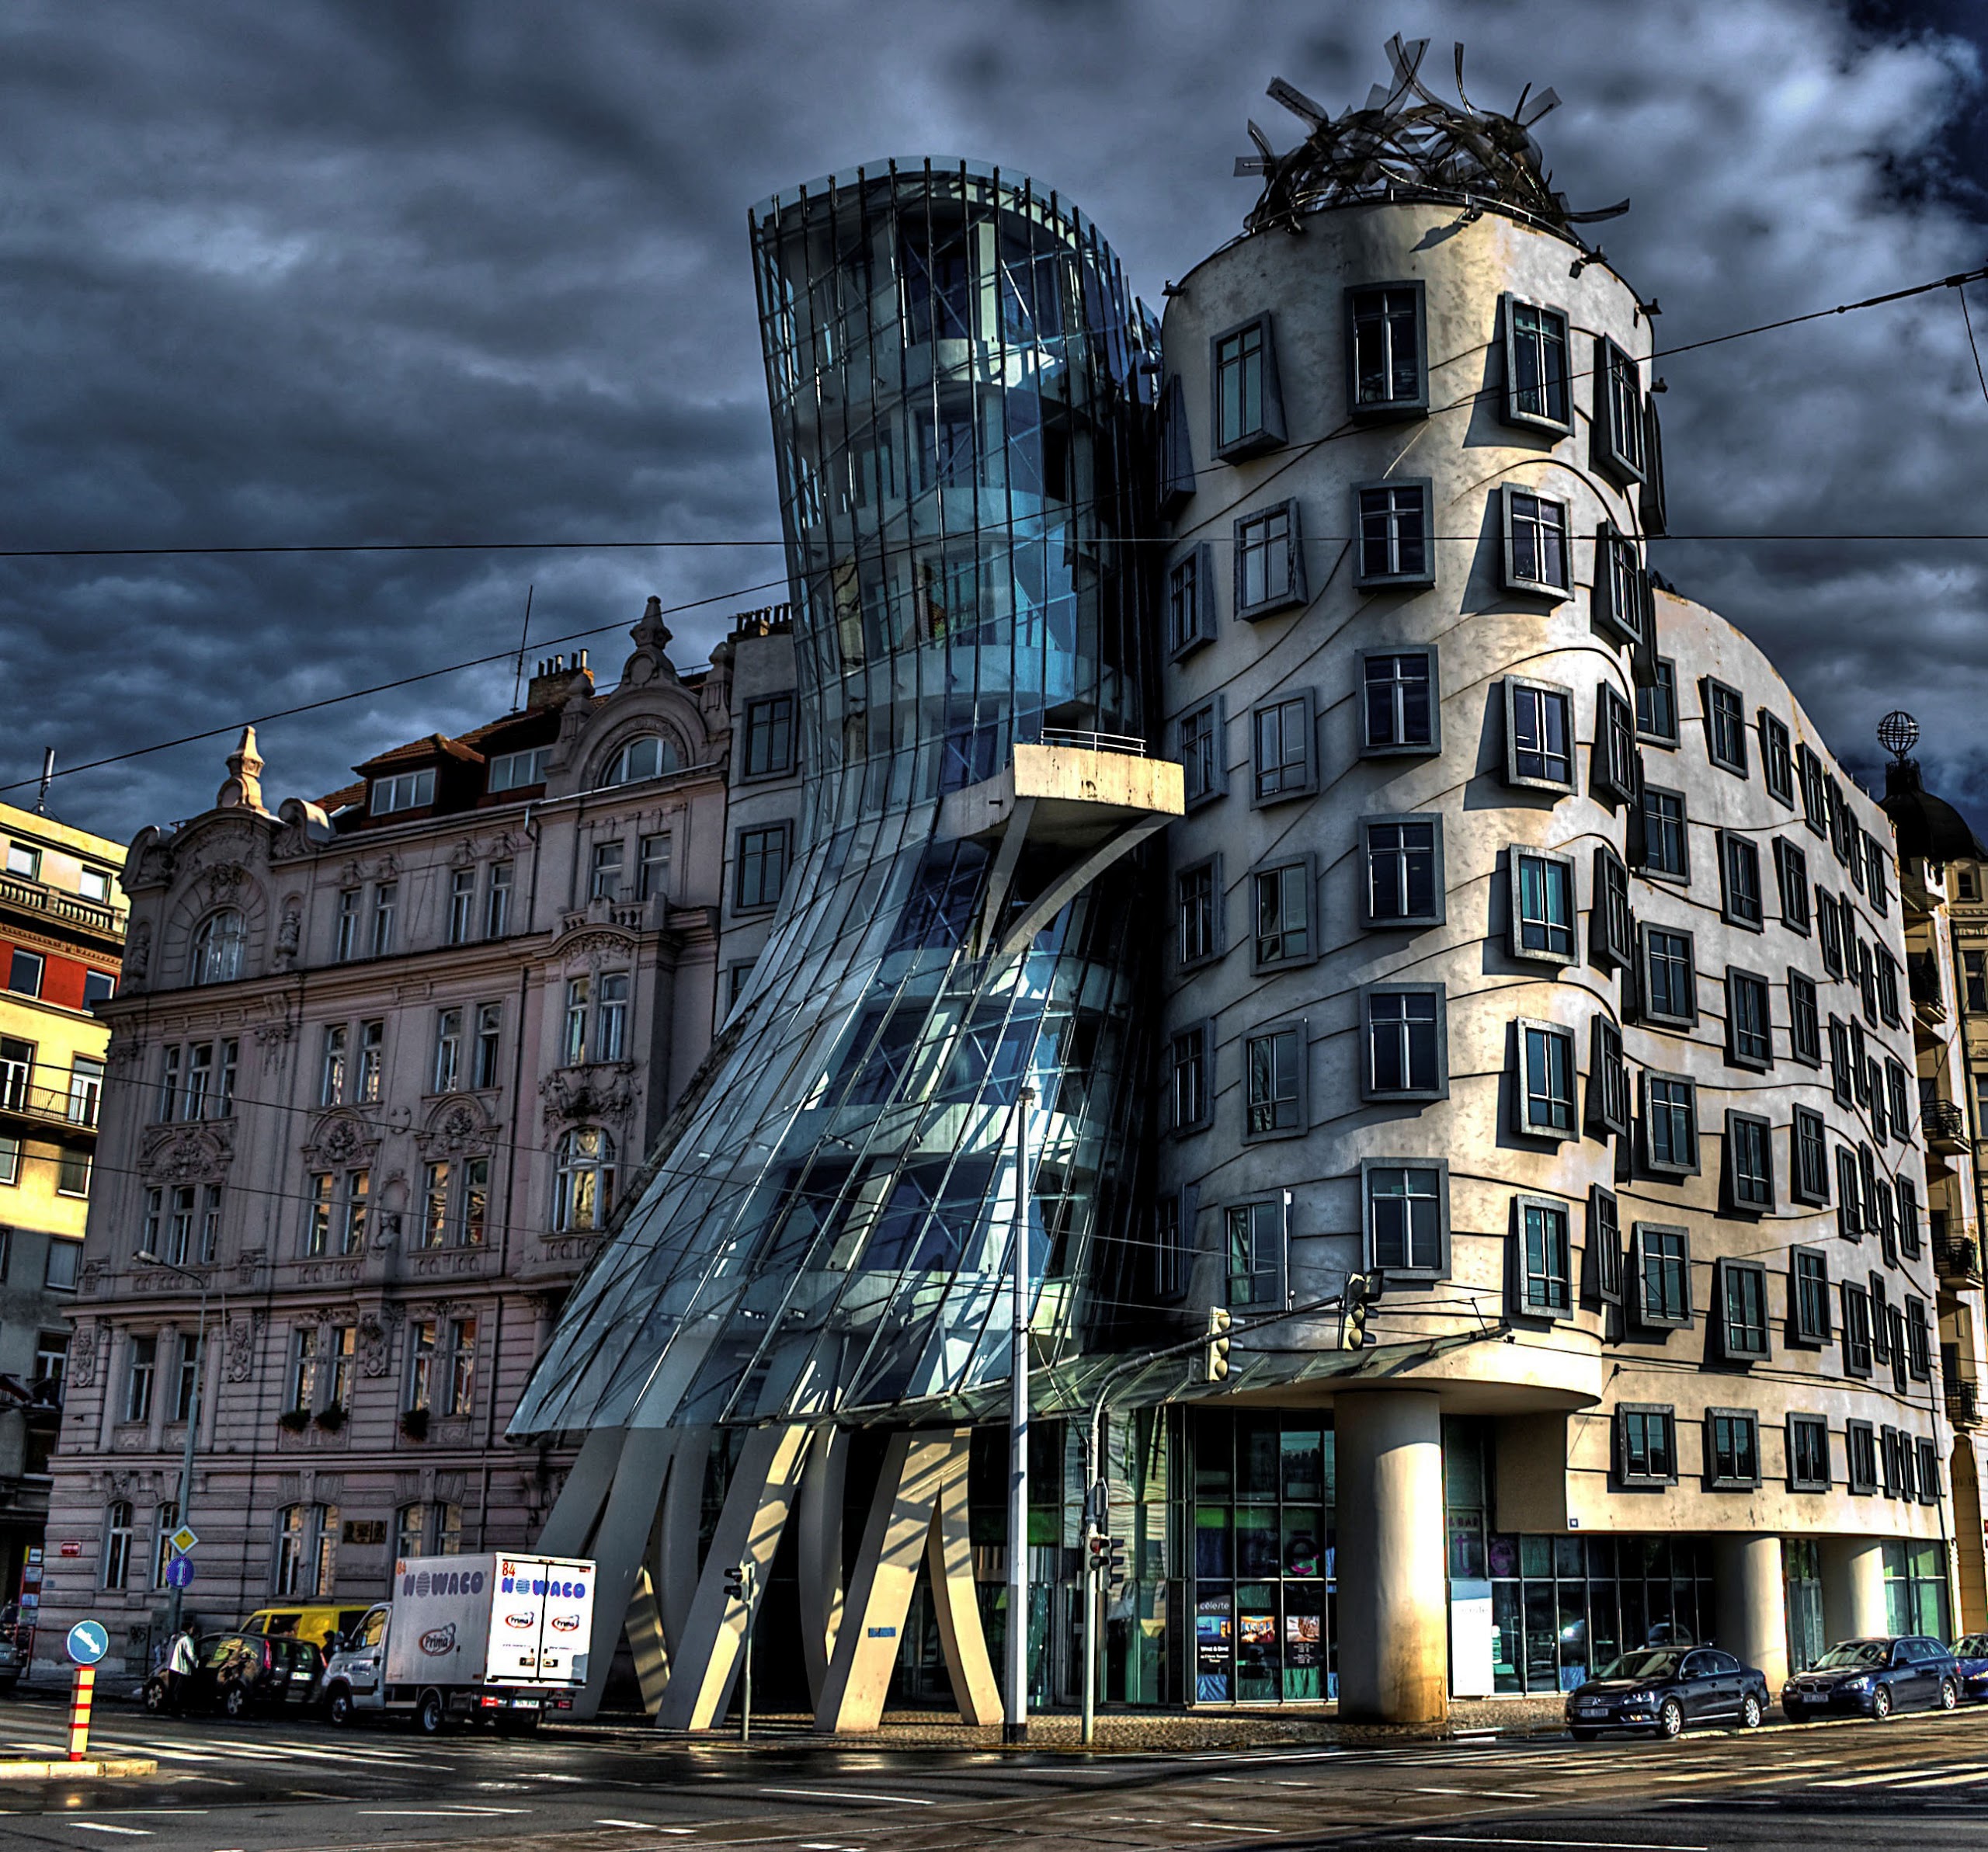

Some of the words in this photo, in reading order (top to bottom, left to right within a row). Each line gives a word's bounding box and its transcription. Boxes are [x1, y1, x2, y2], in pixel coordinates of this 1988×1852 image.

[502, 1562, 516, 1576] 84
[403, 1571, 483, 1597] NOWACO
[502, 1577, 586, 1599] NOWACO
[425, 1635, 448, 1649] Prima
